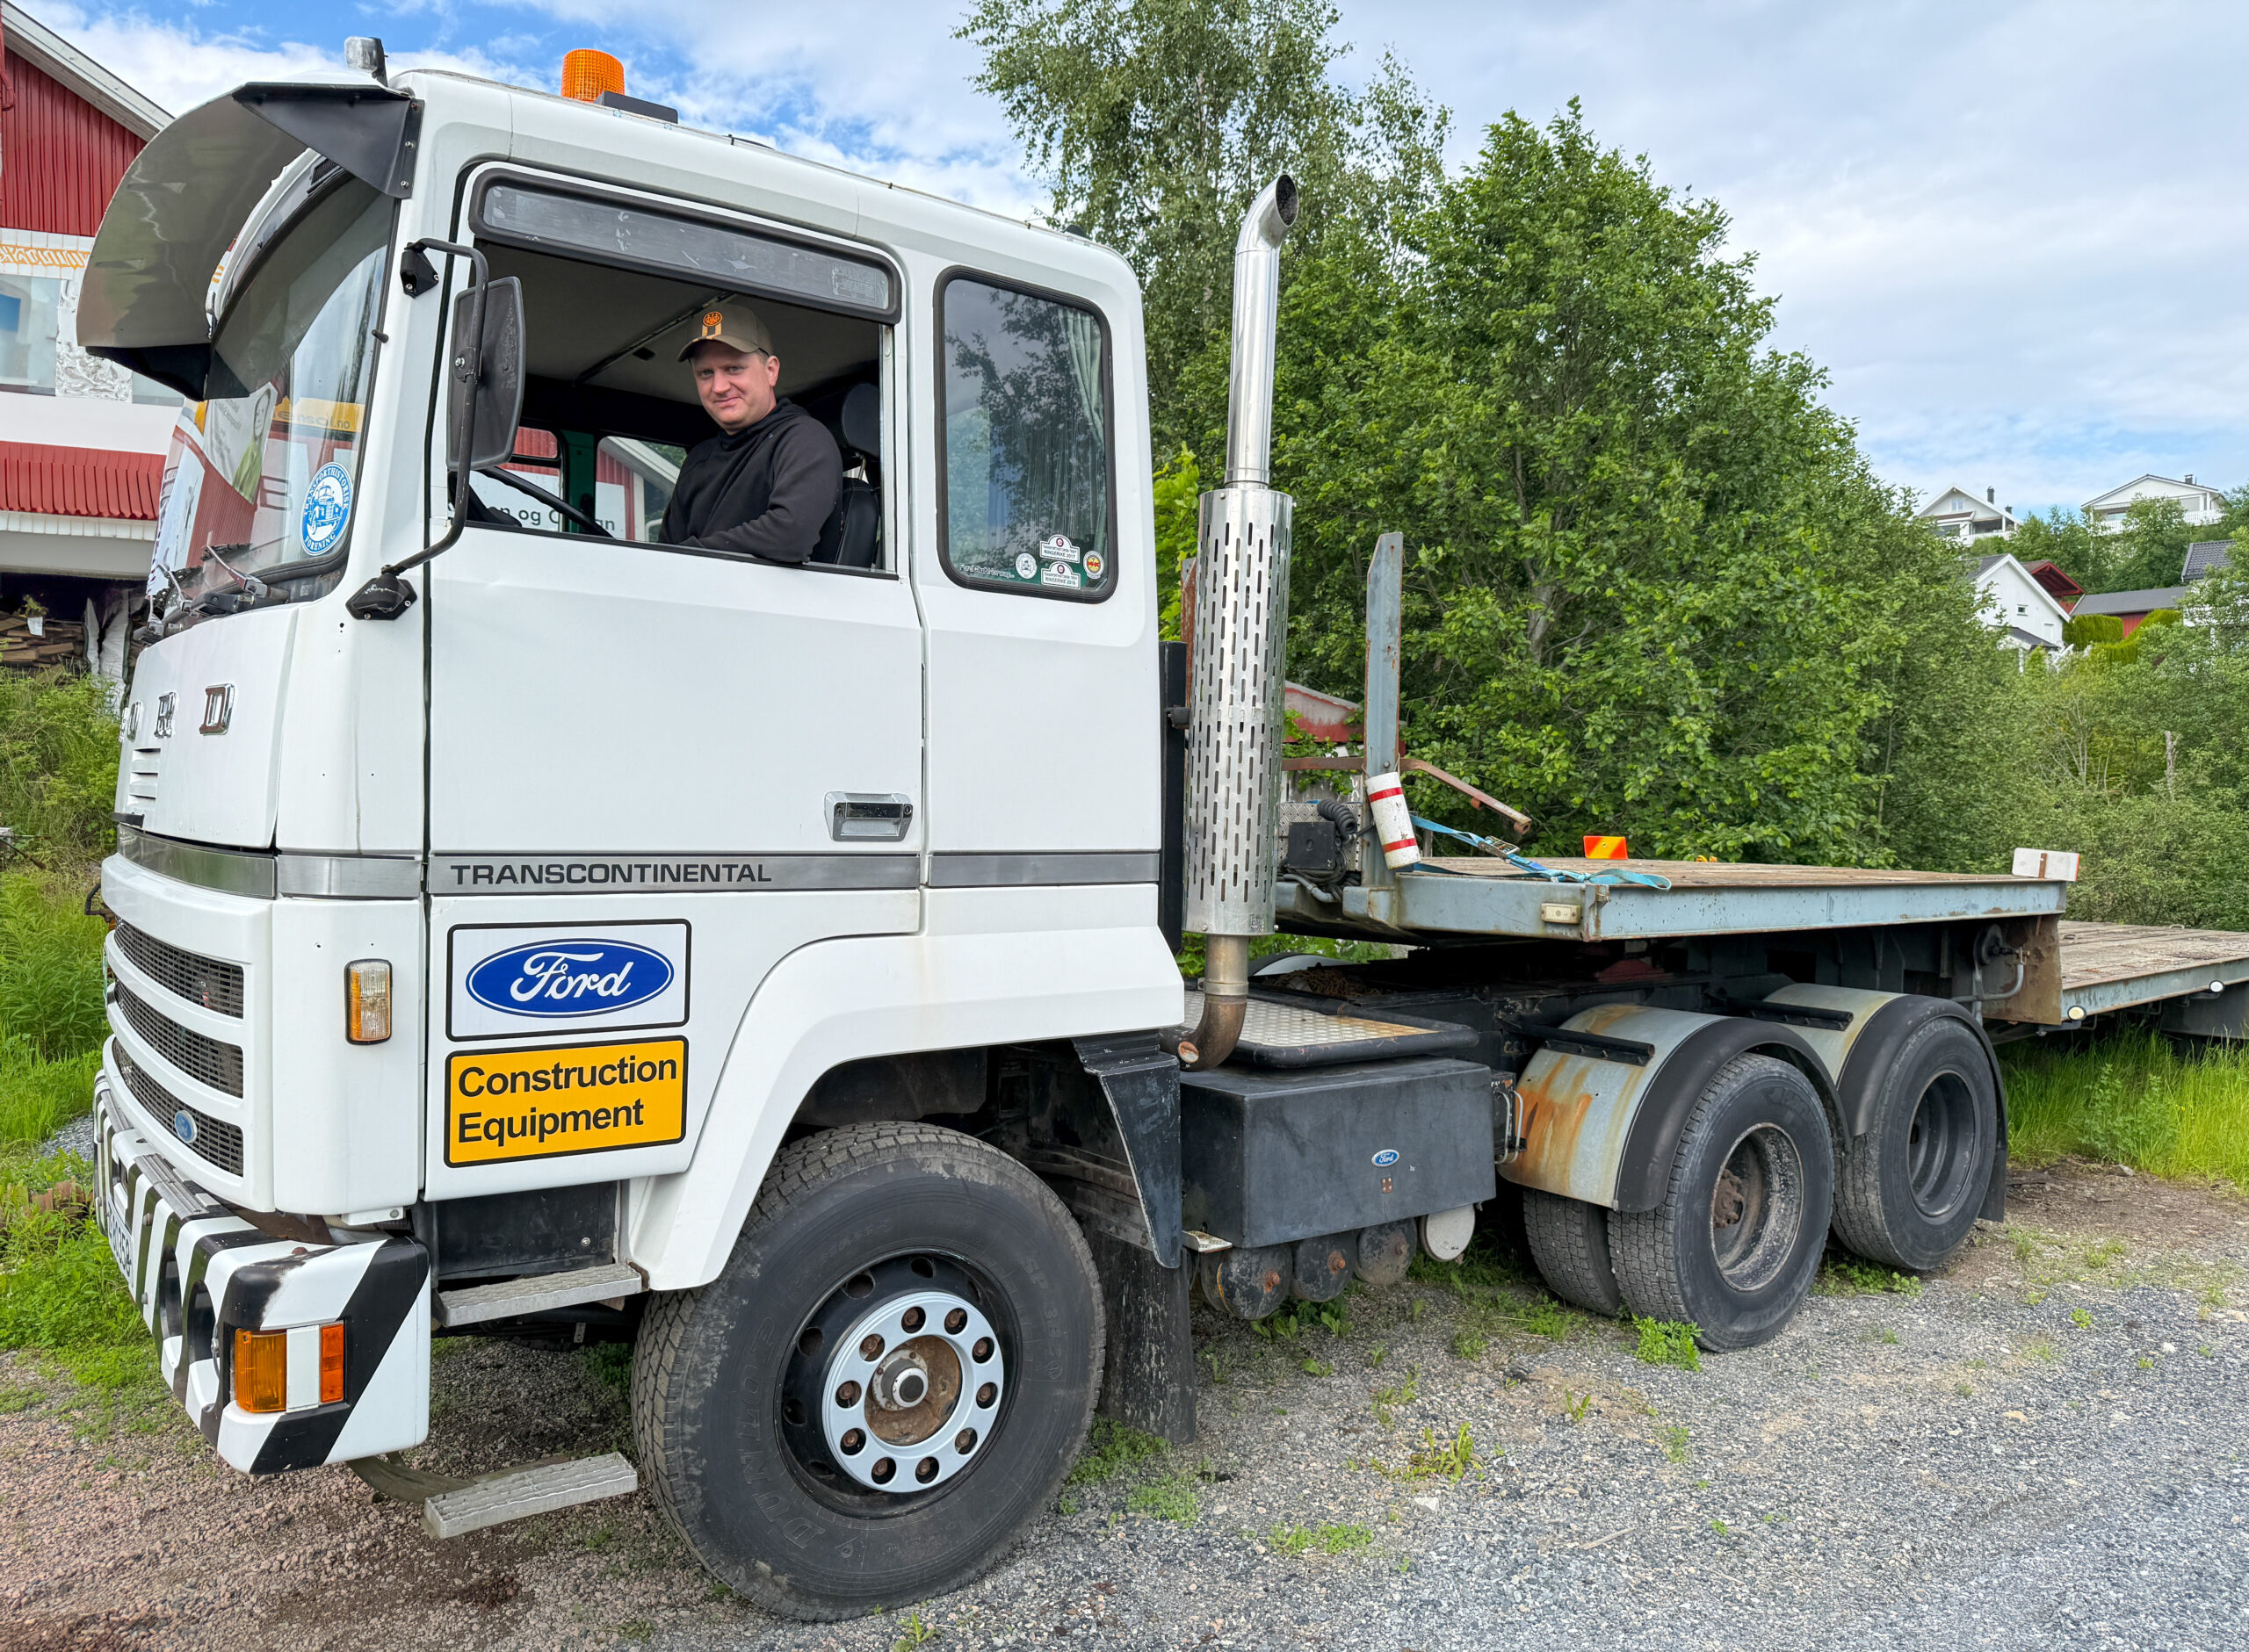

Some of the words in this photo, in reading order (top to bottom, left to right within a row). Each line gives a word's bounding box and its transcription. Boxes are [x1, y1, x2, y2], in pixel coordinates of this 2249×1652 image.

[518, 509, 541, 525] og
[304, 531, 336, 552] FORENING
[451, 863, 772, 885] TRANSCONTINENTAL
[510, 951, 634, 1002] Ford
[459, 1054, 677, 1098] Construction
[459, 1098, 644, 1147] Equipment
[1378, 1152, 1393, 1163] Ford
[737, 1317, 826, 1550] DUNLOP
